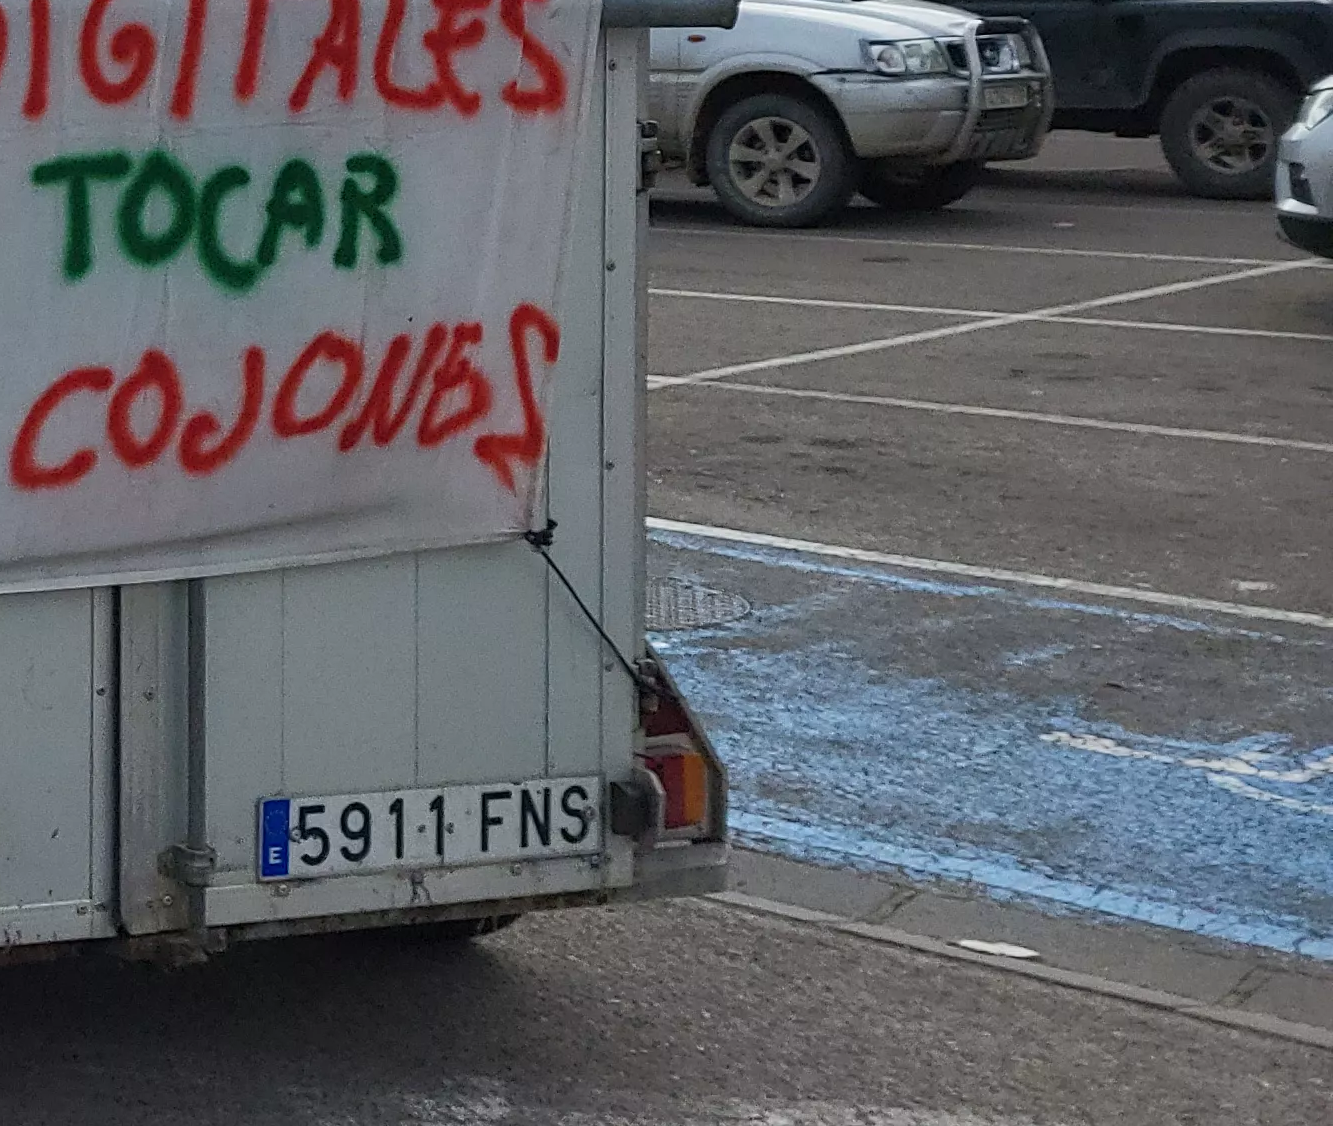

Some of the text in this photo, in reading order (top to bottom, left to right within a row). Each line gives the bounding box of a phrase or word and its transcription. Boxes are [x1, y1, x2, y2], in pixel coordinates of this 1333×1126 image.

[32, 151, 403, 292] TOCAR
[9, 303, 560, 495] COJONES
[268, 847, 282, 865] E
[298, 785, 589, 866] 5911 FNS
